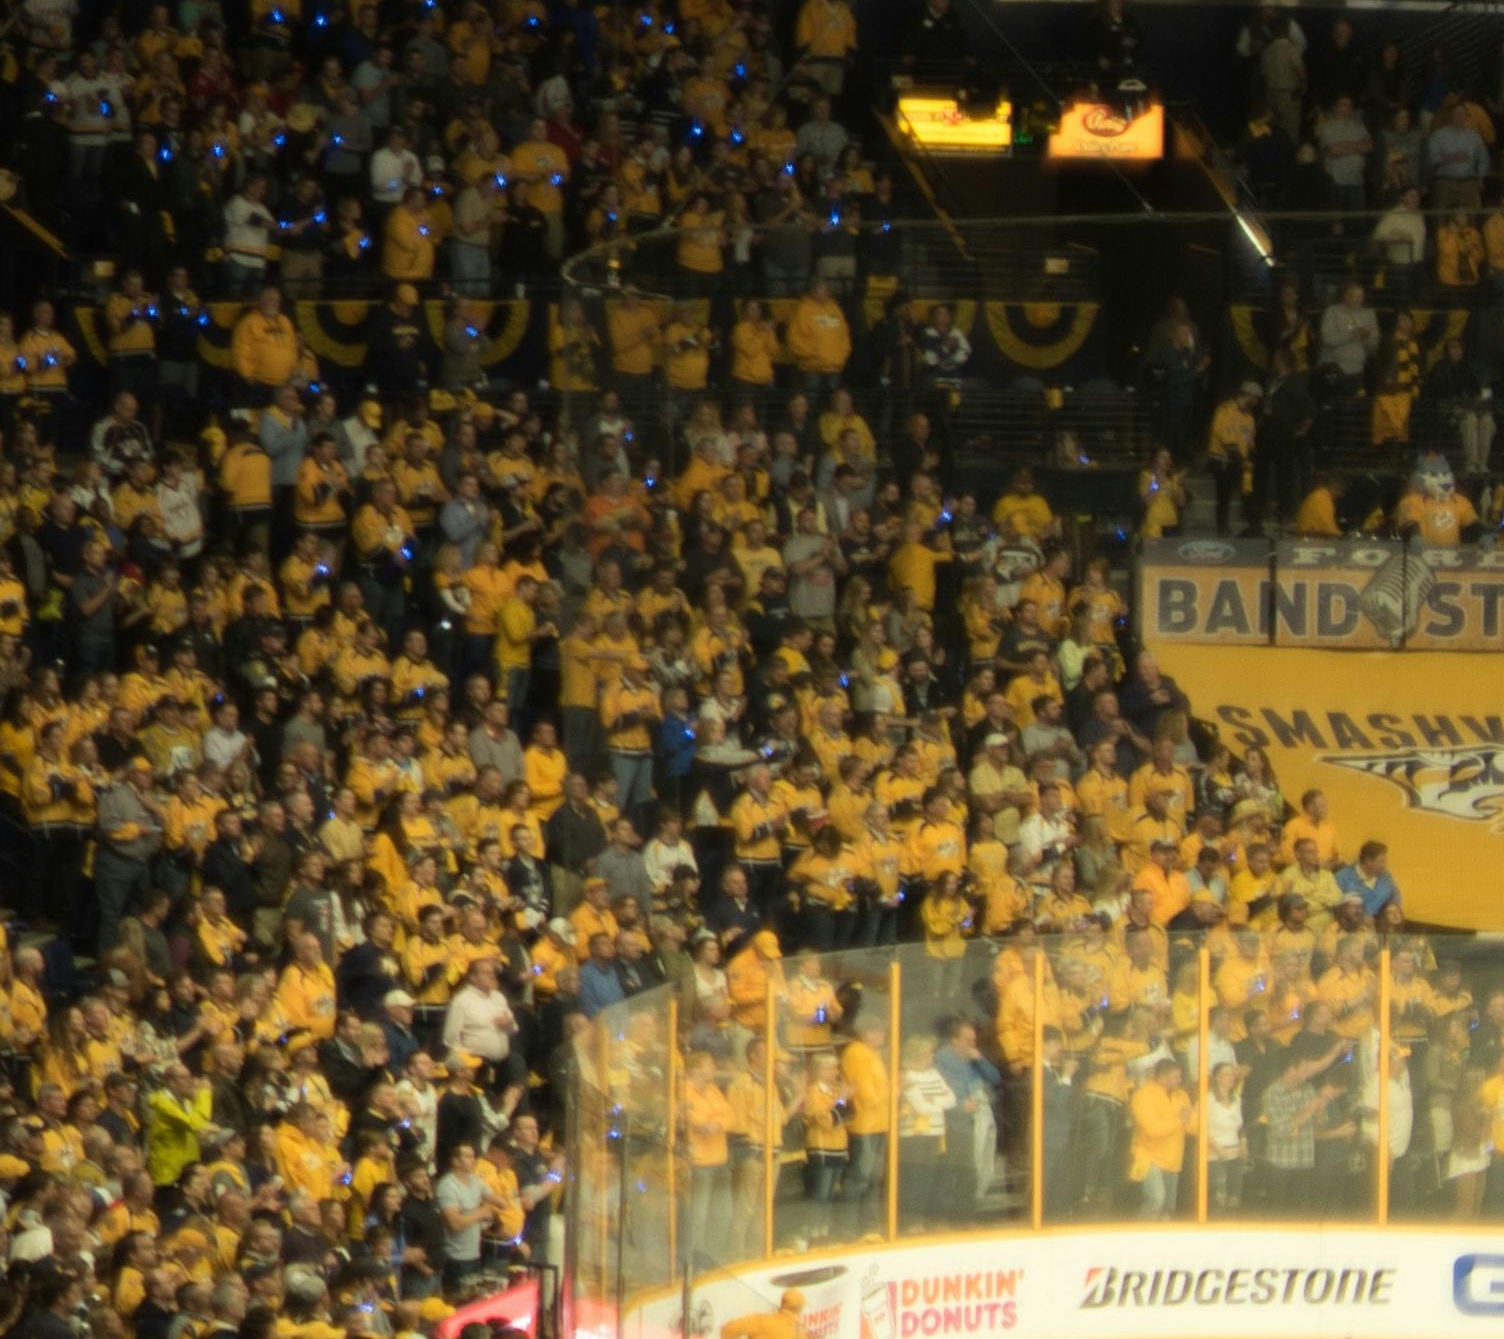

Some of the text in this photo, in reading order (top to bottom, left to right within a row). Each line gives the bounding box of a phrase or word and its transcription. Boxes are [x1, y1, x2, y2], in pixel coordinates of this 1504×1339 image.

[1157, 578, 1363, 637] BAND
[900, 1268, 1025, 1307] DUNKIN'
[1080, 1265, 1397, 1309] BRIDGESTONE
[900, 1300, 1018, 1338] DONUTS
